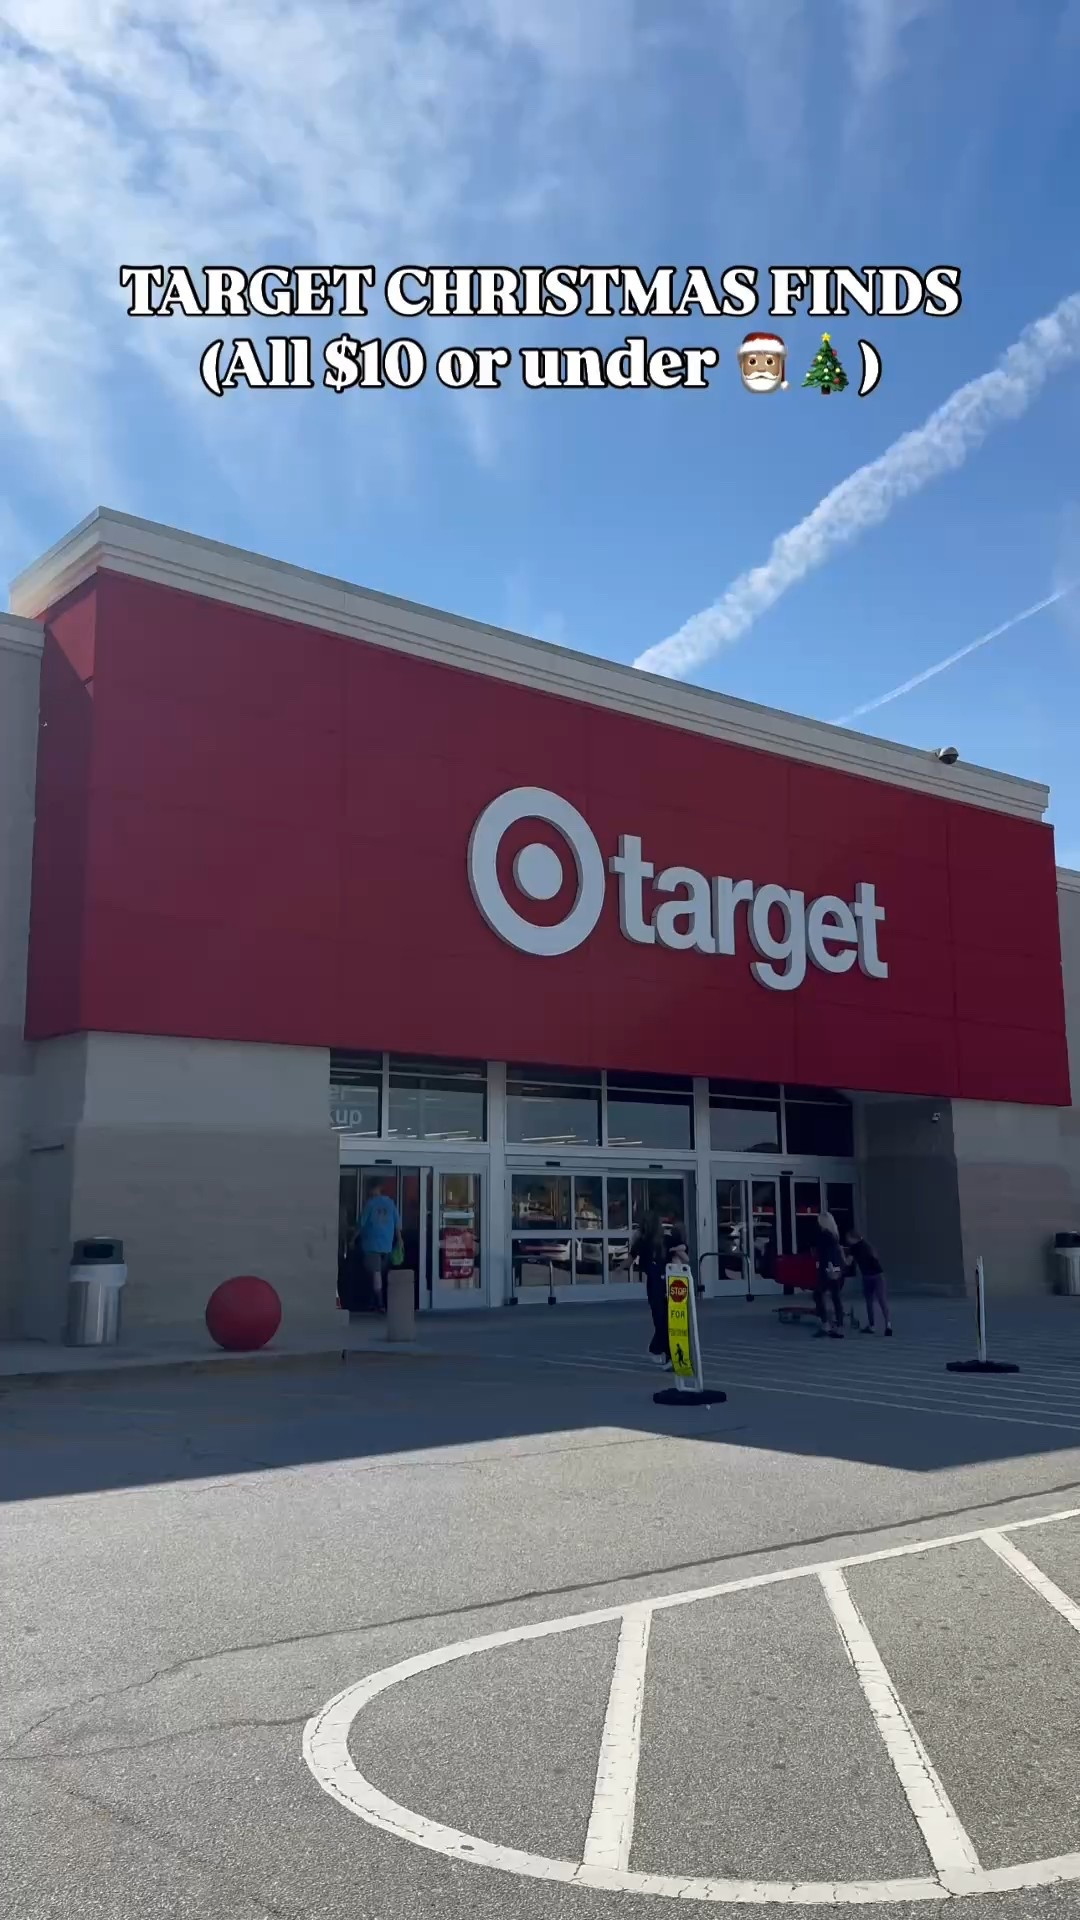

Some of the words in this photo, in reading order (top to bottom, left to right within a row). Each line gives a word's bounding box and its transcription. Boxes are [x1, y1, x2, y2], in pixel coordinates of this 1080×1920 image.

[608, 834, 888, 991] target
[670, 1286, 687, 1296] STOP
[671, 1310, 685, 1319] FOR
